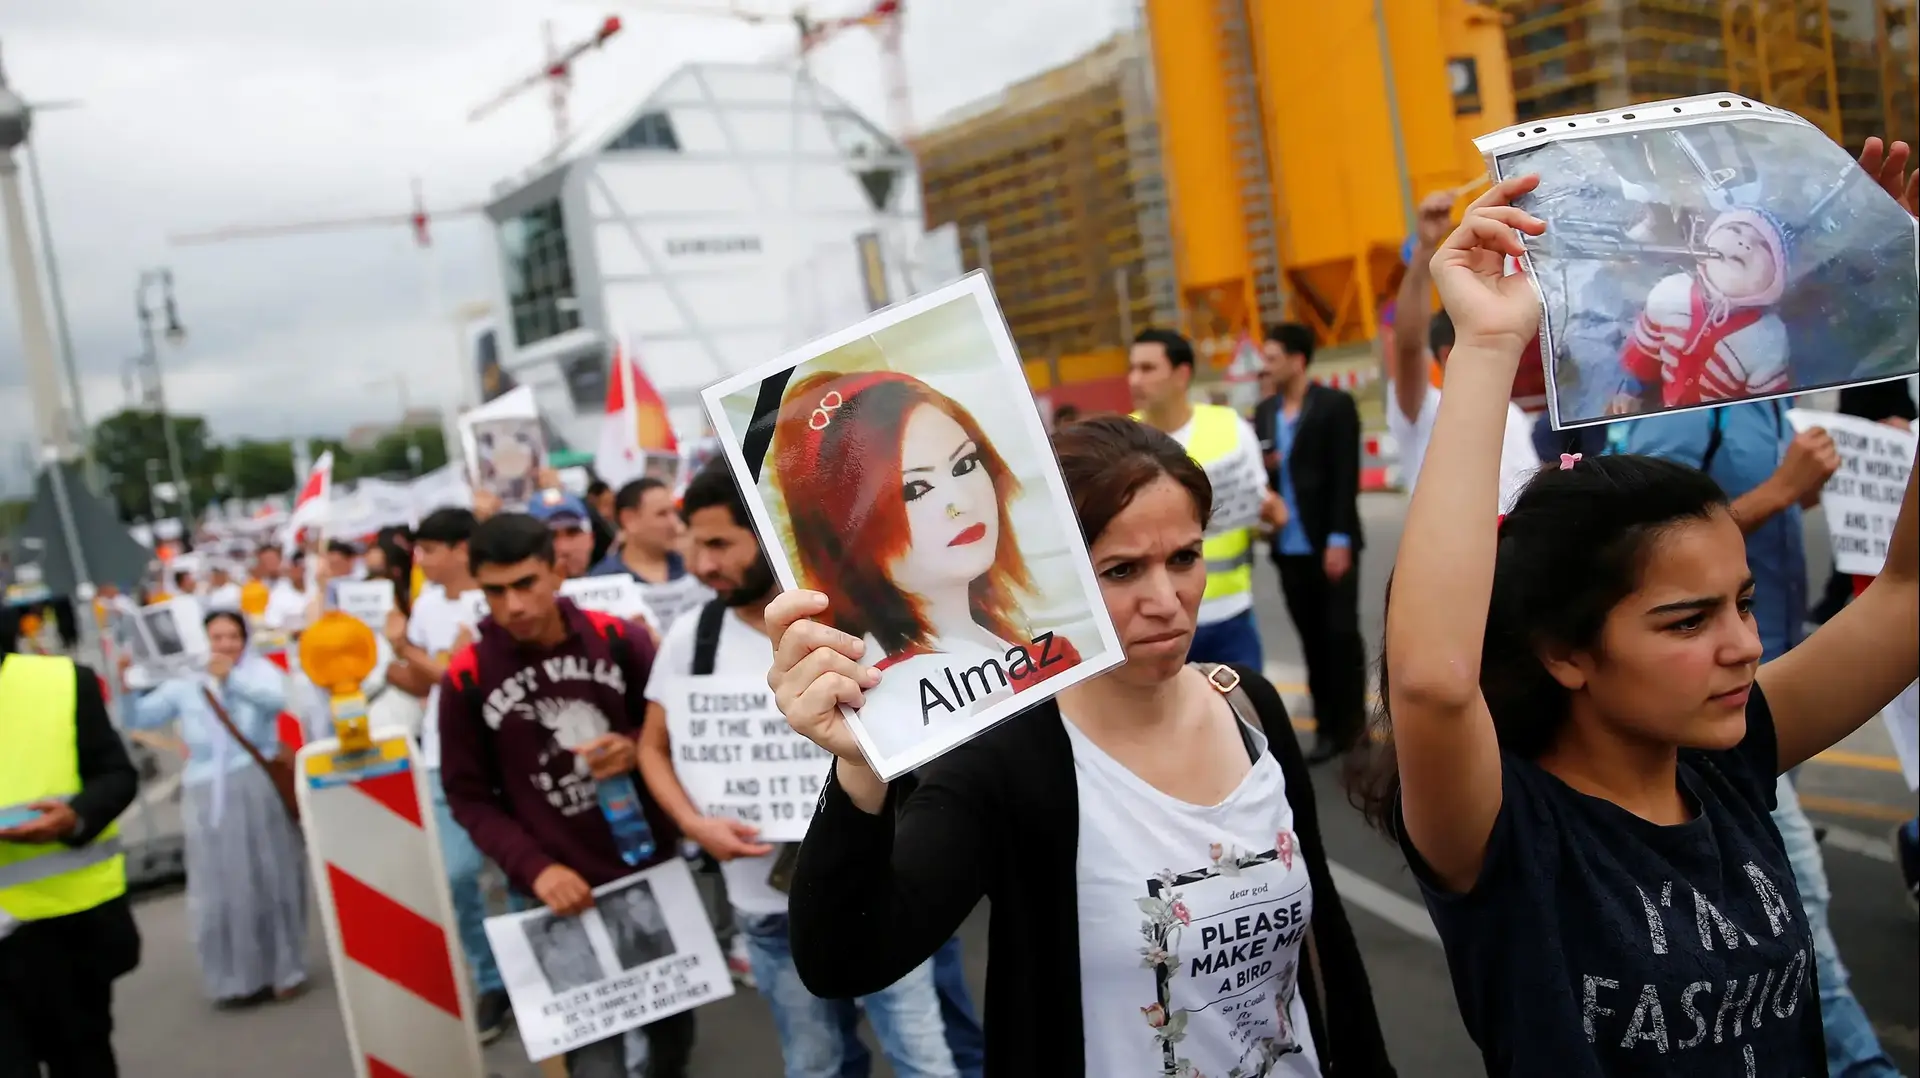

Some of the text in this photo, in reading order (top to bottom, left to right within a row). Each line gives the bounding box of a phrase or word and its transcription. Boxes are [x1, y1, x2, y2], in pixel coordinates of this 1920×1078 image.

[919, 631, 1063, 726] Almaz
[688, 692, 767, 714] EZIDISM
[717, 718, 751, 737] THE
[760, 719, 791, 736] WO
[752, 743, 829, 762] RELIGI
[724, 776, 818, 796] AND IT IS
[770, 803, 794, 820] TO
[1229, 883, 1269, 900] dear god
[1743, 860, 1792, 937] A
[1201, 901, 1303, 950] PLEASE
[1191, 923, 1305, 977] MAKE ME
[1218, 960, 1272, 993] A BIRD
[1583, 949, 1806, 1054] FASHIO
